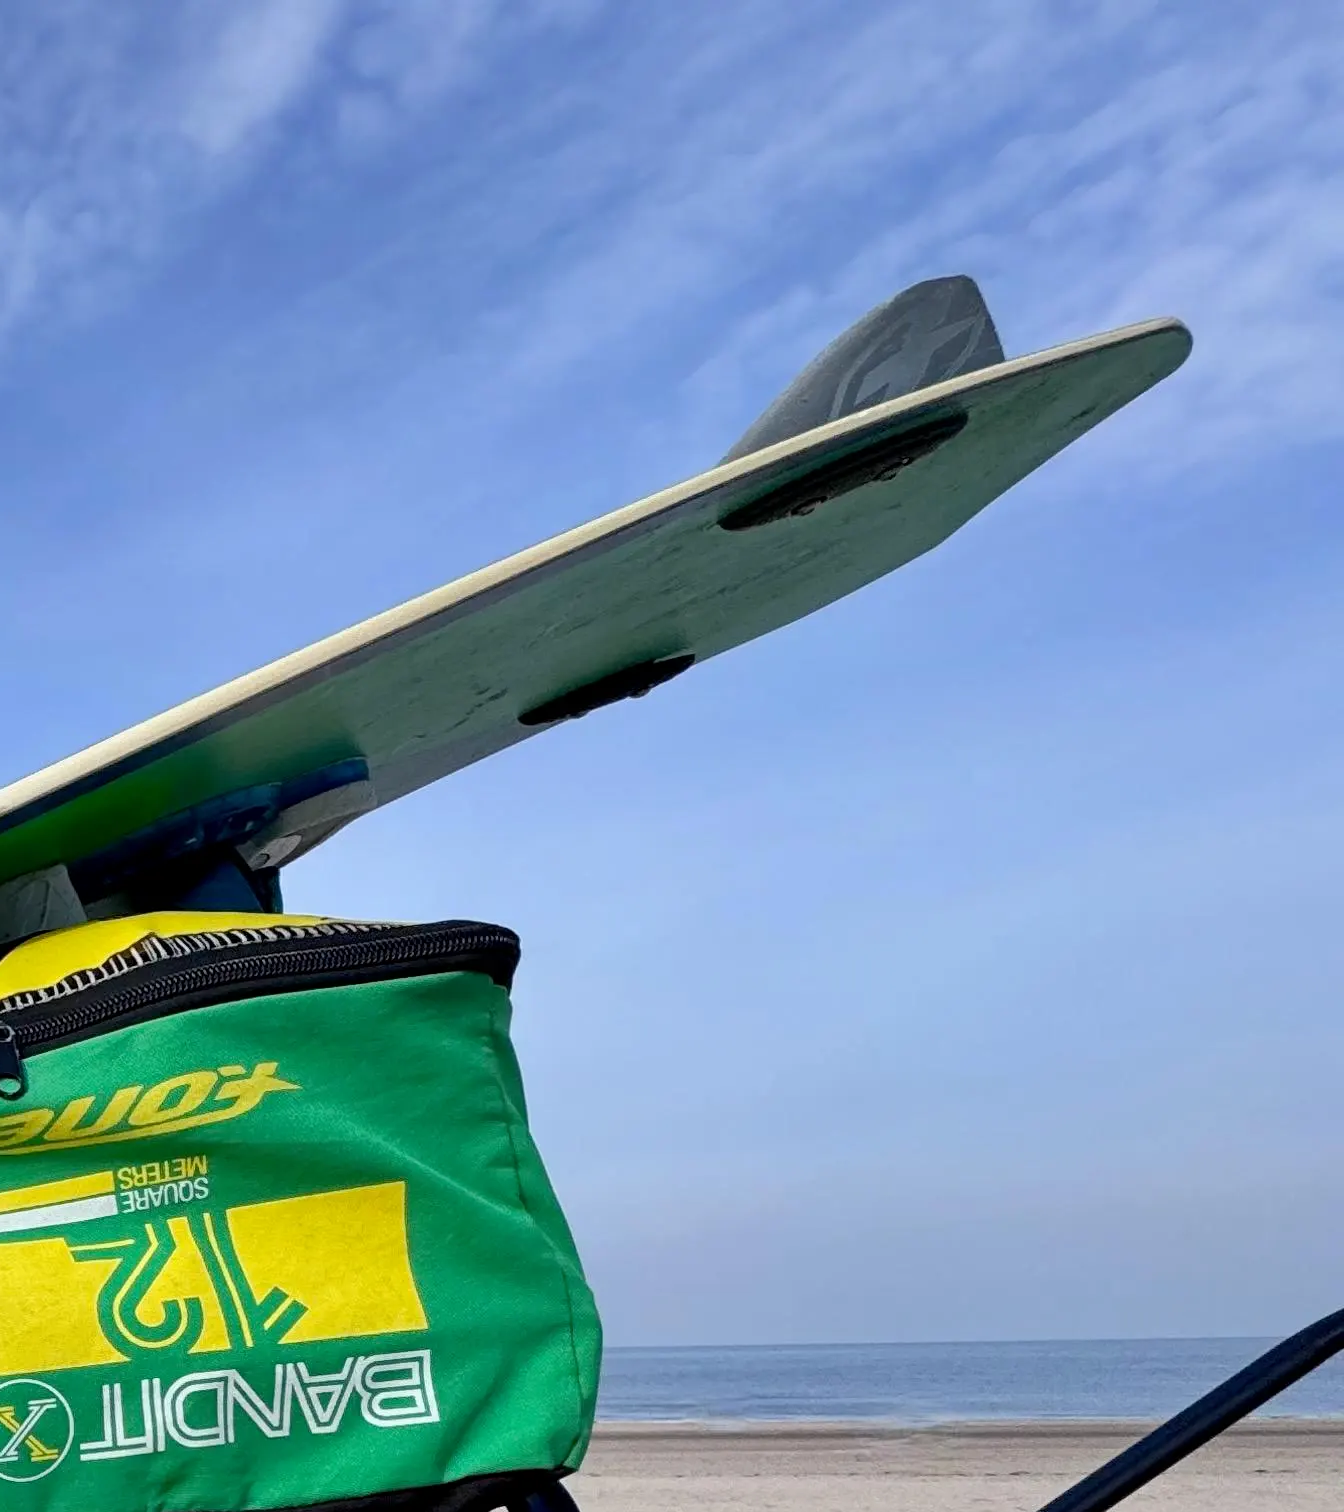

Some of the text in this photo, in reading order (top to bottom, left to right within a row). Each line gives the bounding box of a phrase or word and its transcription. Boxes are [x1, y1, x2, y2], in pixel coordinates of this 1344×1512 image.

[117, 1154, 208, 1188] METERS
[121, 1176, 210, 1214] SQUARE
[70, 1212, 310, 1363] 12
[79, 1349, 441, 1462] BANDIT
